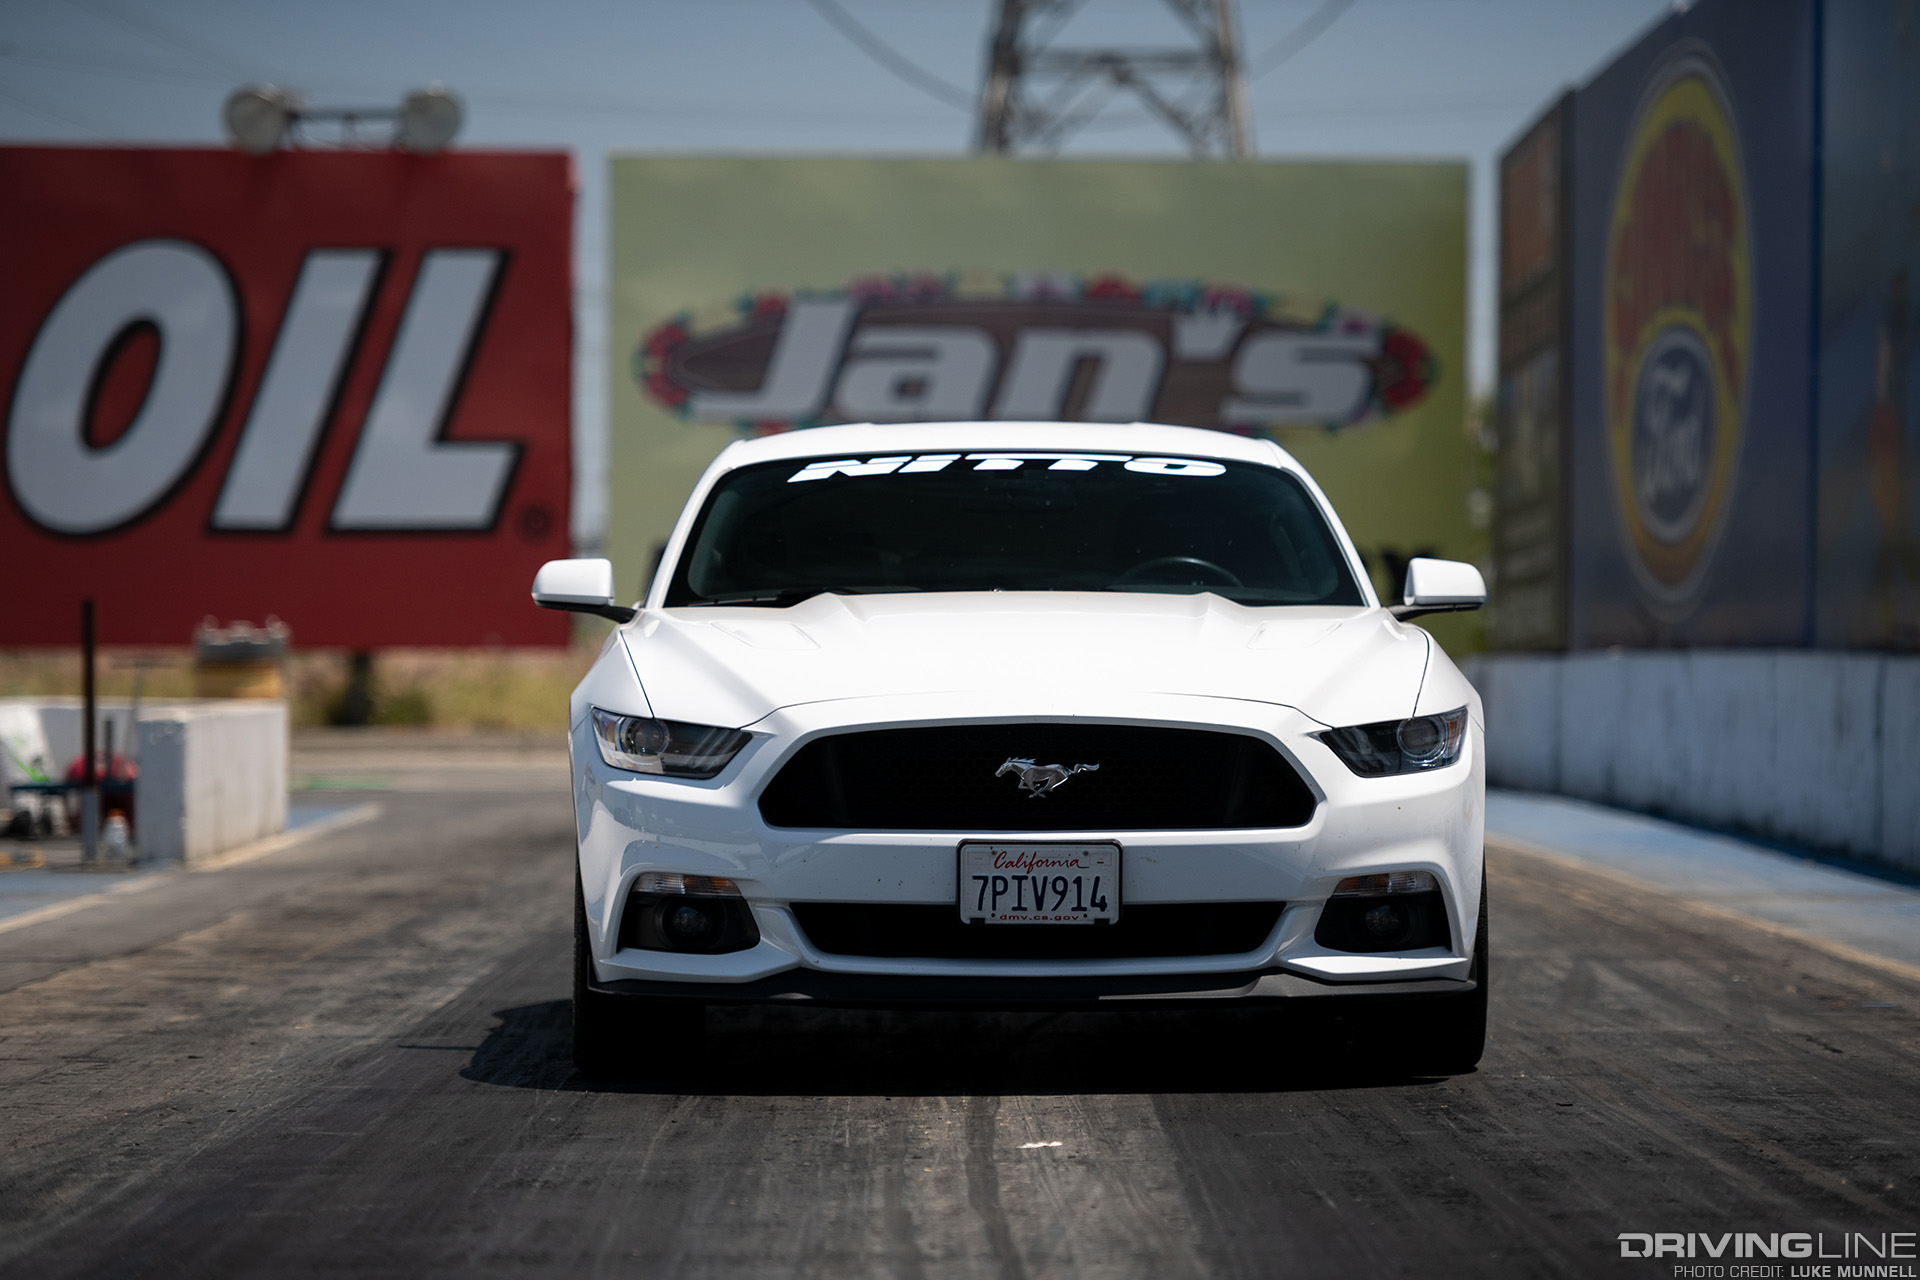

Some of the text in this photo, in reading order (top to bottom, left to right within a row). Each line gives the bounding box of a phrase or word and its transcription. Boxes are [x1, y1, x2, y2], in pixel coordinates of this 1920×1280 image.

[687, 298, 1384, 424] Jan's
[5, 236, 525, 538] OIL
[787, 452, 1228, 483] NITTO
[993, 850, 1090, 875] California
[972, 875, 1108, 912] 7PIV914
